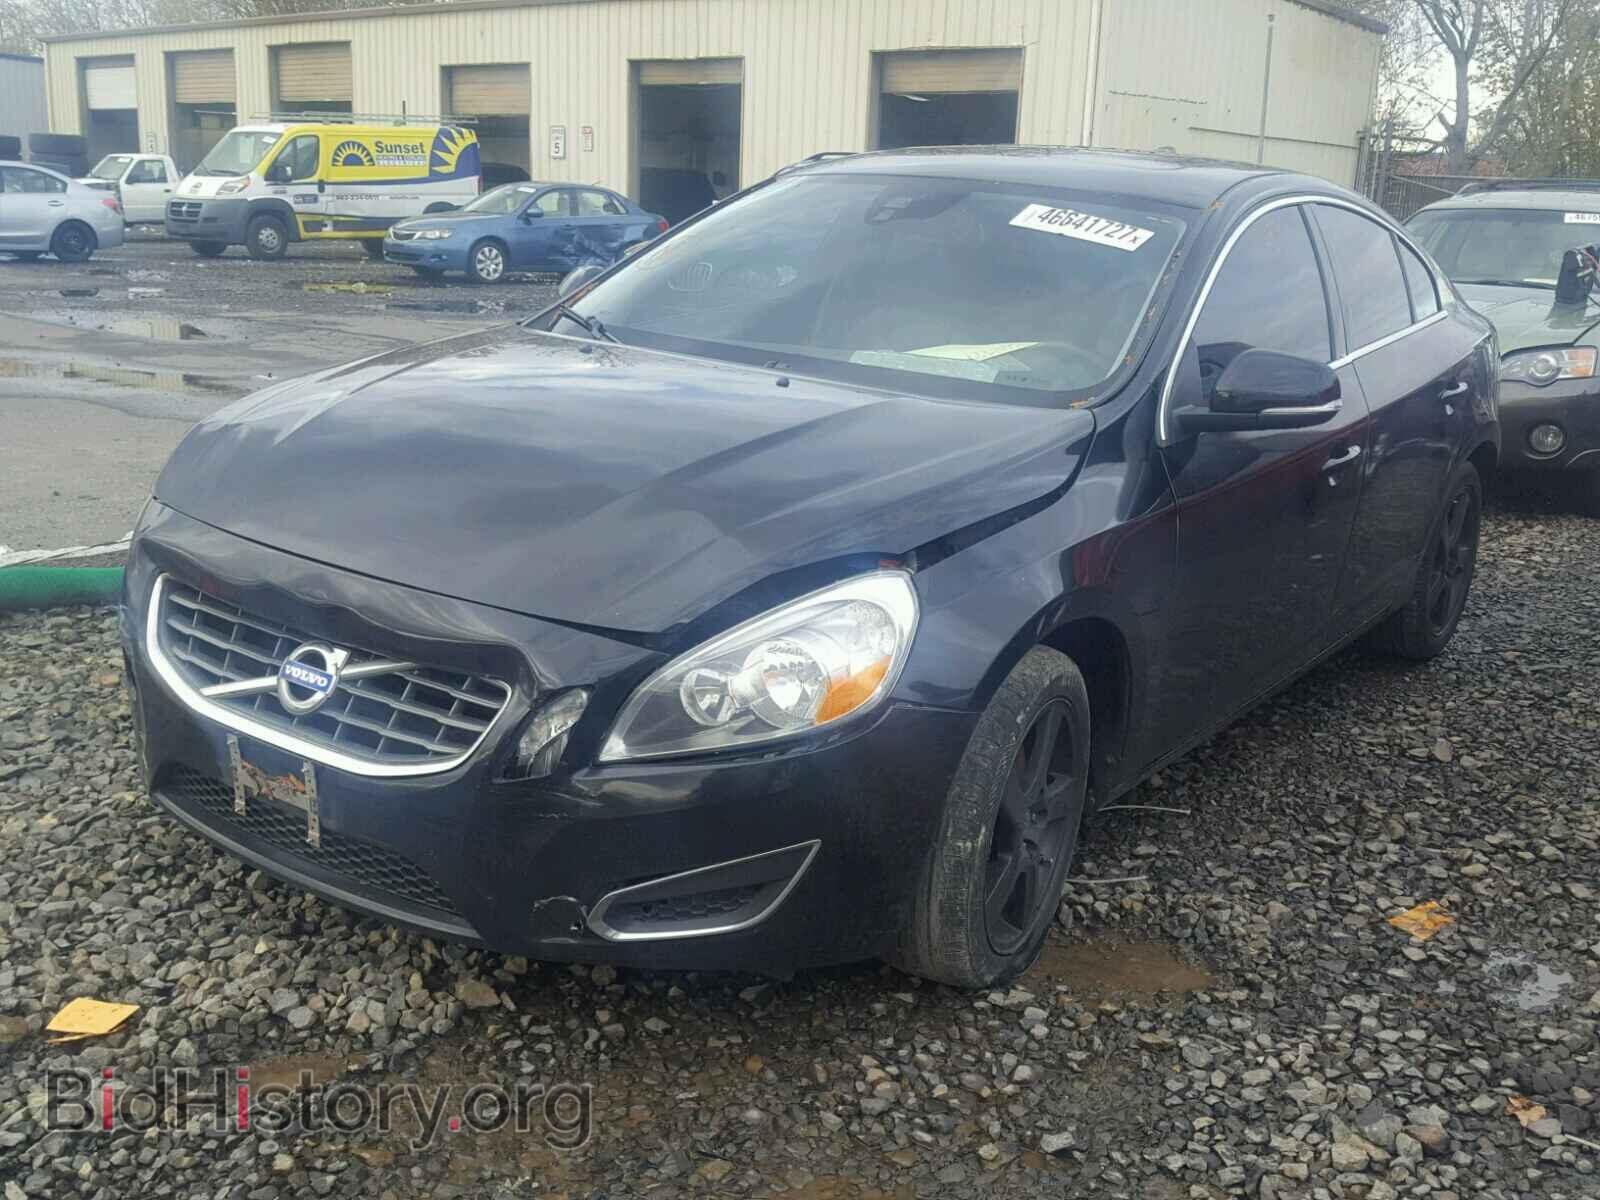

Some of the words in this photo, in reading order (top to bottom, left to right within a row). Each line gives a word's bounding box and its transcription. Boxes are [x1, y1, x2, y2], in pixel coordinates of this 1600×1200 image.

[375, 140, 425, 154] Sunset
[554, 142, 560, 154] 5
[285, 664, 329, 687] VOLVO
